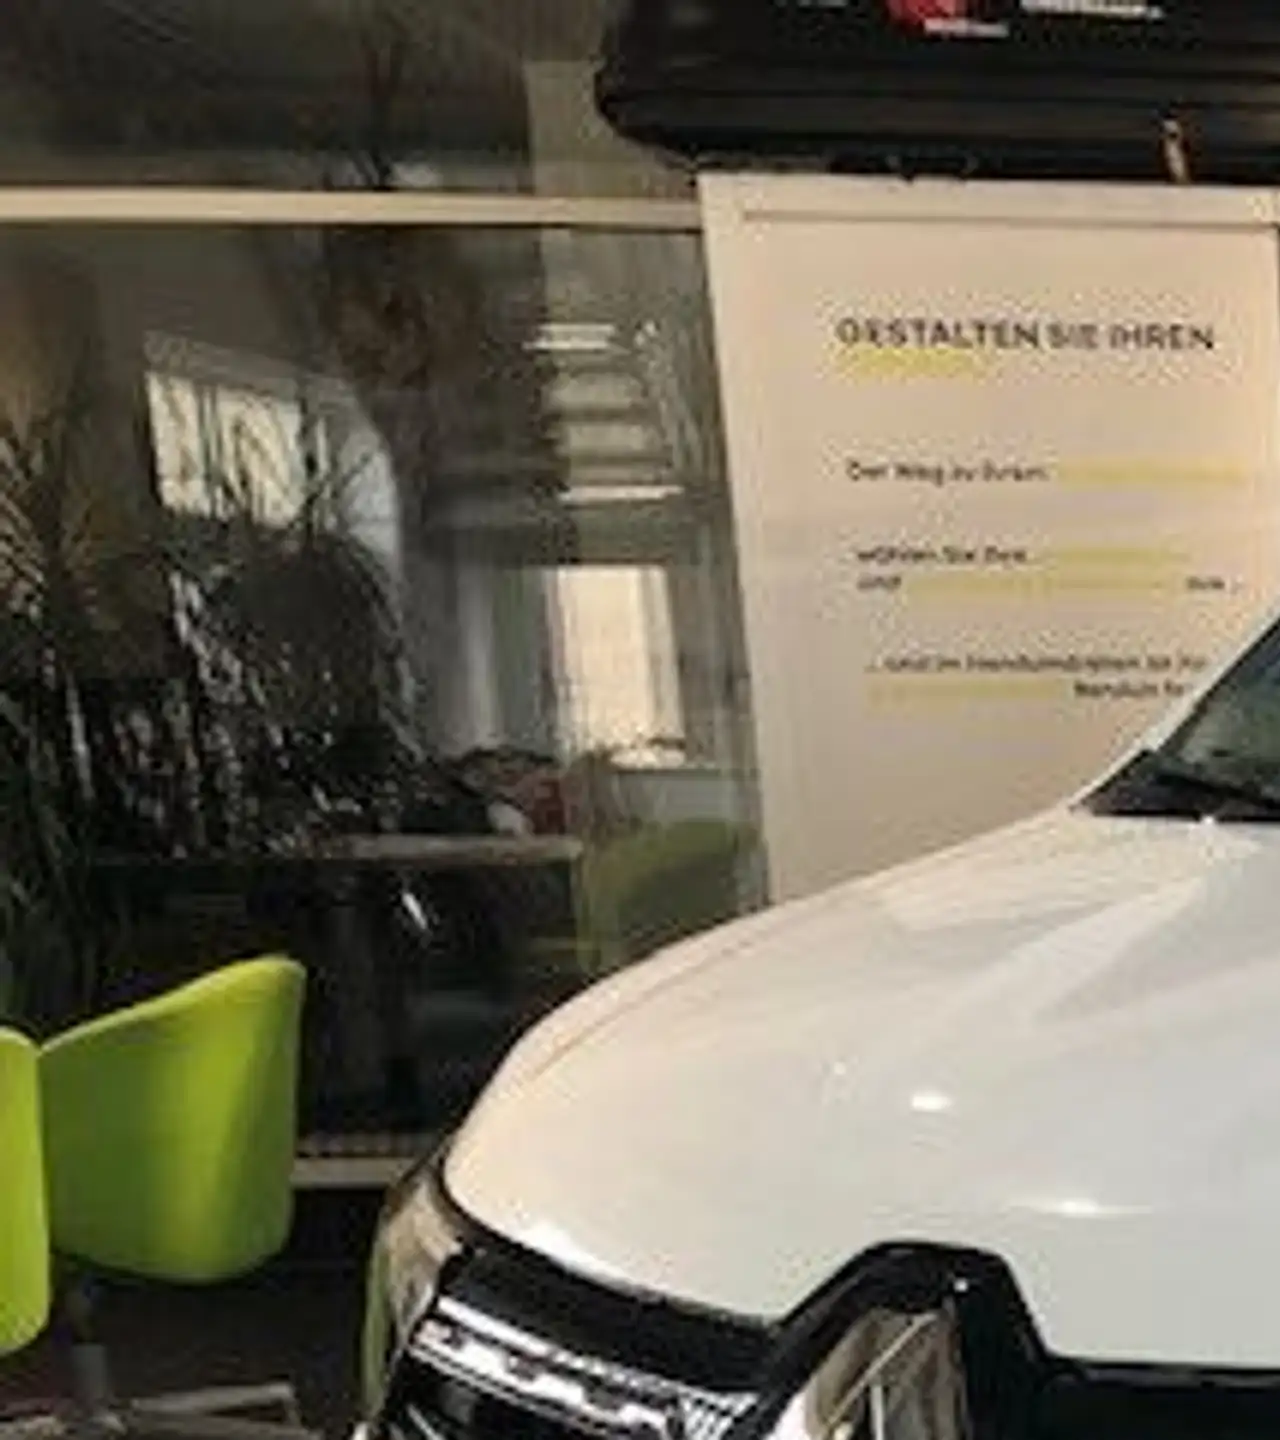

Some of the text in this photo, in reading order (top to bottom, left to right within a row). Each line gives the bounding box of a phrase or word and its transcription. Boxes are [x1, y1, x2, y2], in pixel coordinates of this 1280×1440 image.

[835, 317, 1215, 351] GESTALTEN SIE IHREN
